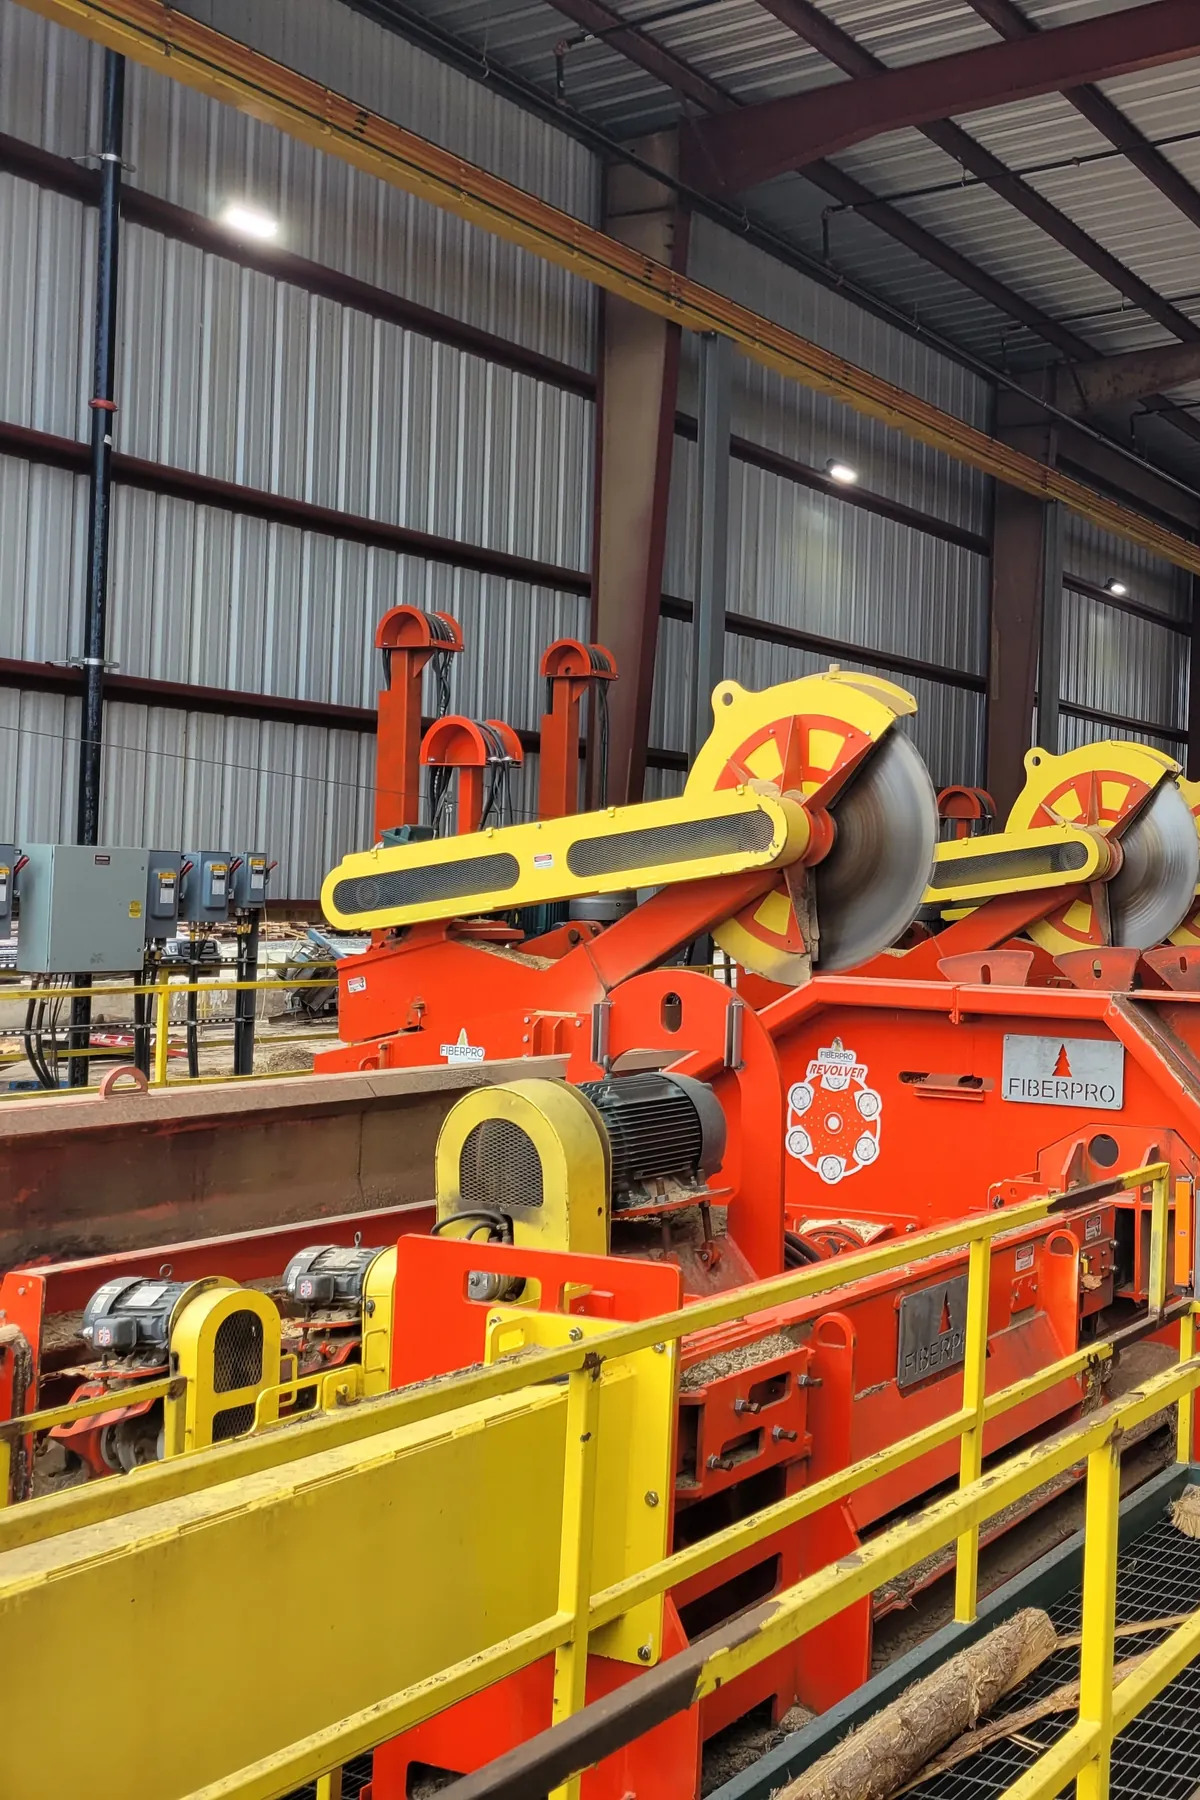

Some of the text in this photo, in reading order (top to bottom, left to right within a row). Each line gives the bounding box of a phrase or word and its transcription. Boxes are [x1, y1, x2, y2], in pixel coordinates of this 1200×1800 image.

[440, 1045, 484, 1058] FIBERPRO
[820, 1051, 854, 1061] FIBERPRO
[809, 1063, 865, 1079] REVOLVER
[1009, 1077, 1115, 1103] FIBERPRO
